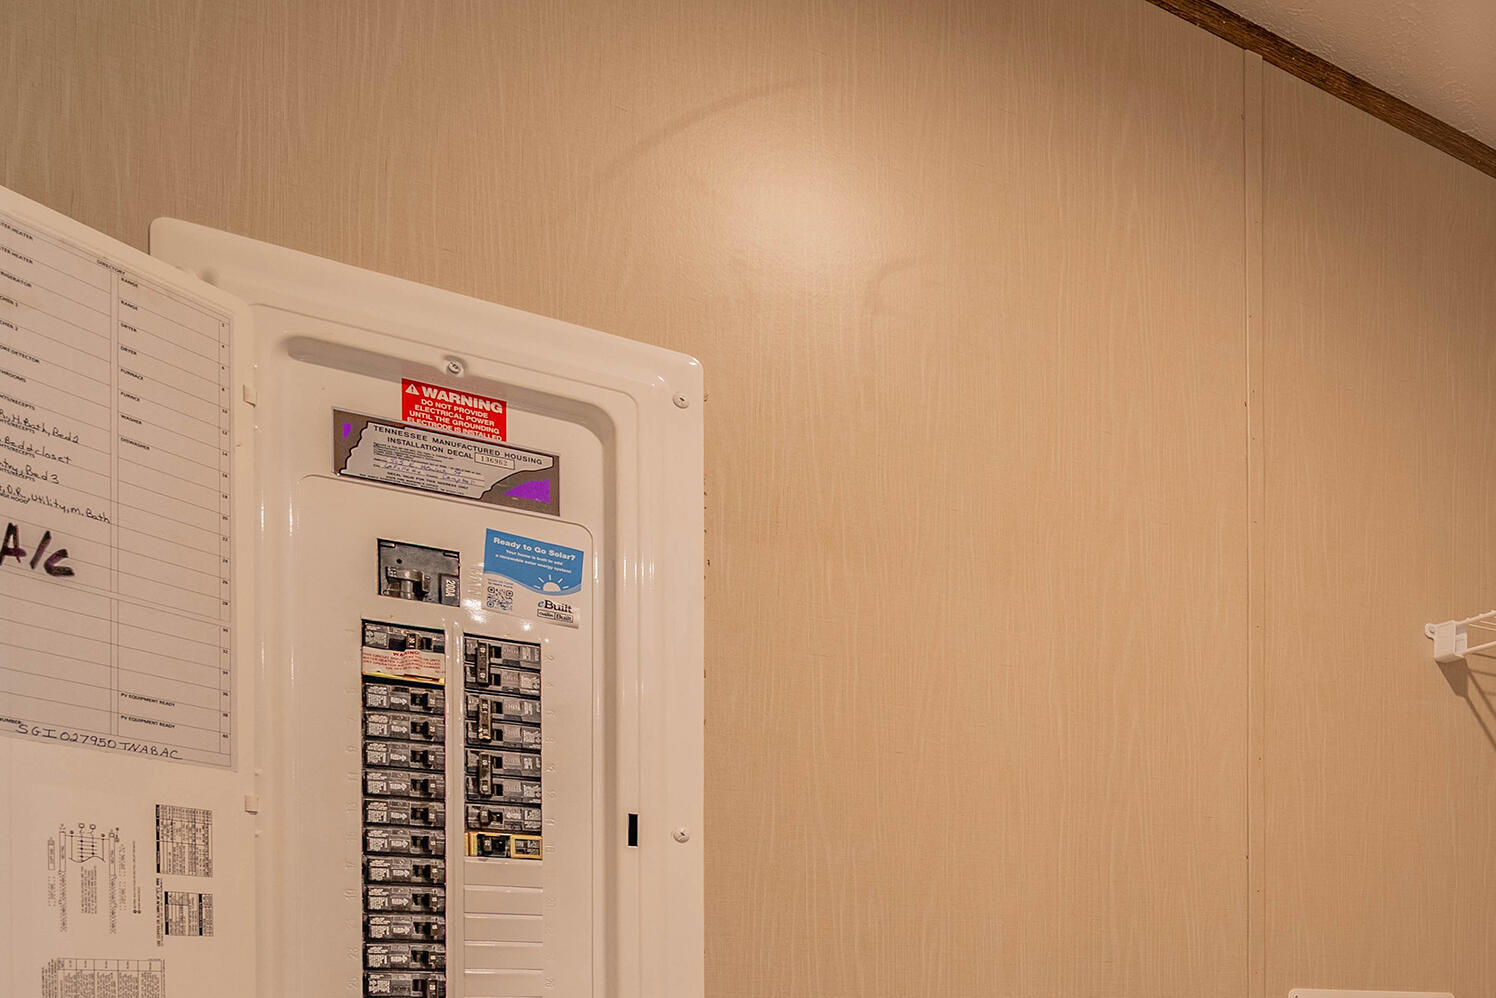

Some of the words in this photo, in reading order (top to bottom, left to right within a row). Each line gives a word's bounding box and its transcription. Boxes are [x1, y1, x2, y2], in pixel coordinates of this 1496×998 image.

[421, 385, 503, 414] WARNING
[421, 398, 433, 407] DO
[435, 402, 451, 410] NOT
[453, 406, 489, 419] PROVIDE
[409, 410, 433, 420] UNTIL
[434, 415, 450, 424] THE
[451, 419, 500, 435] GROUNDING
[415, 404, 463, 420] ELECTRICAL
[465, 415, 495, 427] POWER
[407, 416, 453, 432] ELECTRODE
[462, 428, 502, 441] INSTALLED
[373, 425, 428, 442] TENNESSEE
[432, 437, 501, 457] MANUFACTURED
[504, 452, 543, 465] HOUSING
[387, 436, 444, 453] INSTALLATION
[447, 448, 474, 460] DECAL
[493, 537, 521, 549] Ready
[522, 543, 532, 551] to
[534, 546, 547, 555] Go
[548, 548, 576, 561] Solar?
[537, 599, 573, 614] eBuilt
